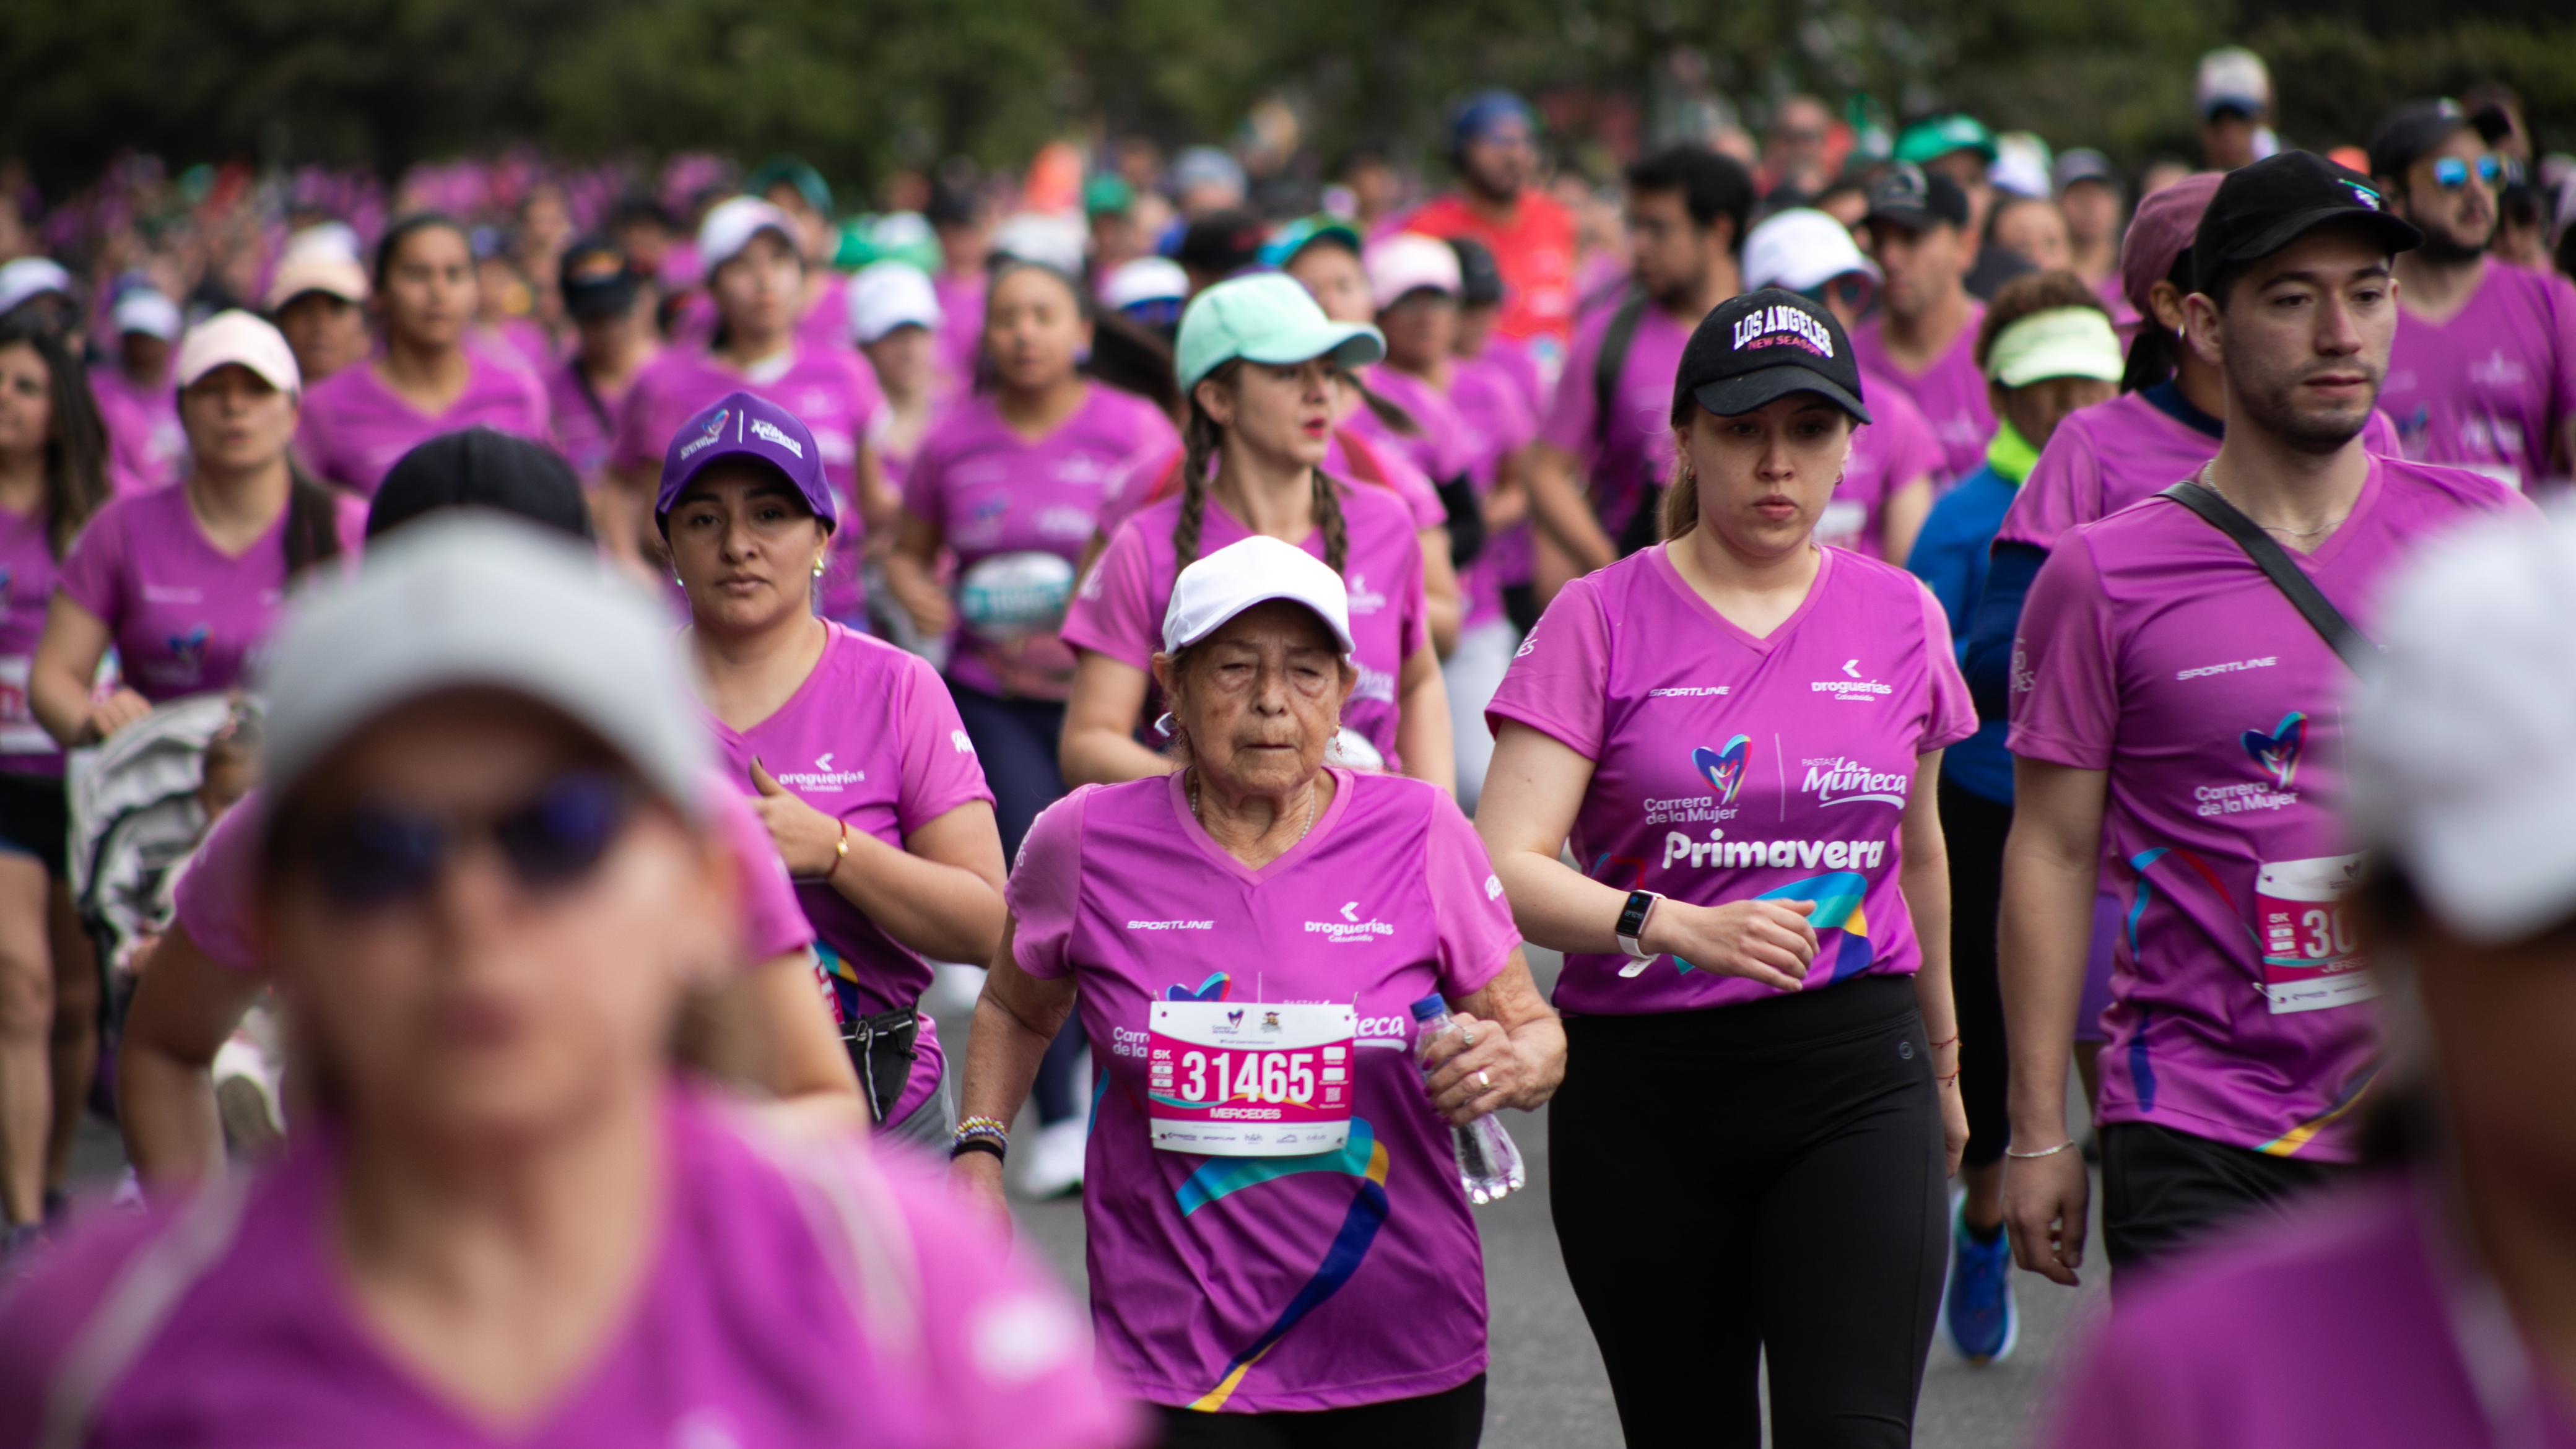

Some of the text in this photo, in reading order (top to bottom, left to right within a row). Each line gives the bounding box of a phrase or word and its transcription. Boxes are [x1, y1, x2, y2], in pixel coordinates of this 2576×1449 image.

[1733, 305, 1834, 358] LOS ANGELES
[1747, 335, 1822, 357] NEW SEASON
[2176, 657, 2278, 681] SPORTLINE
[1648, 686, 1731, 697] SPORTLINE
[1811, 679, 1892, 694] Droguerías
[1801, 757, 1858, 773] PASTAS La
[1801, 767, 1907, 801] Muñeca
[2194, 782, 2268, 801] Carrera
[1643, 796, 1712, 813] Carrera
[2196, 791, 2298, 817] de la Mujer
[1645, 805, 1738, 825] de la Mujer
[1662, 828, 1886, 869] Primavera
[1127, 920, 1214, 930] SPORTLINE
[1305, 918, 1393, 936] Droguerías
[1113, 1027, 1150, 1043] Carr
[1113, 1041, 1149, 1058] de la
[1152, 1049, 1172, 1060] 5K
[1181, 1051, 1315, 1103] 31465
[1210, 1108, 1281, 1120] MERCEDES
